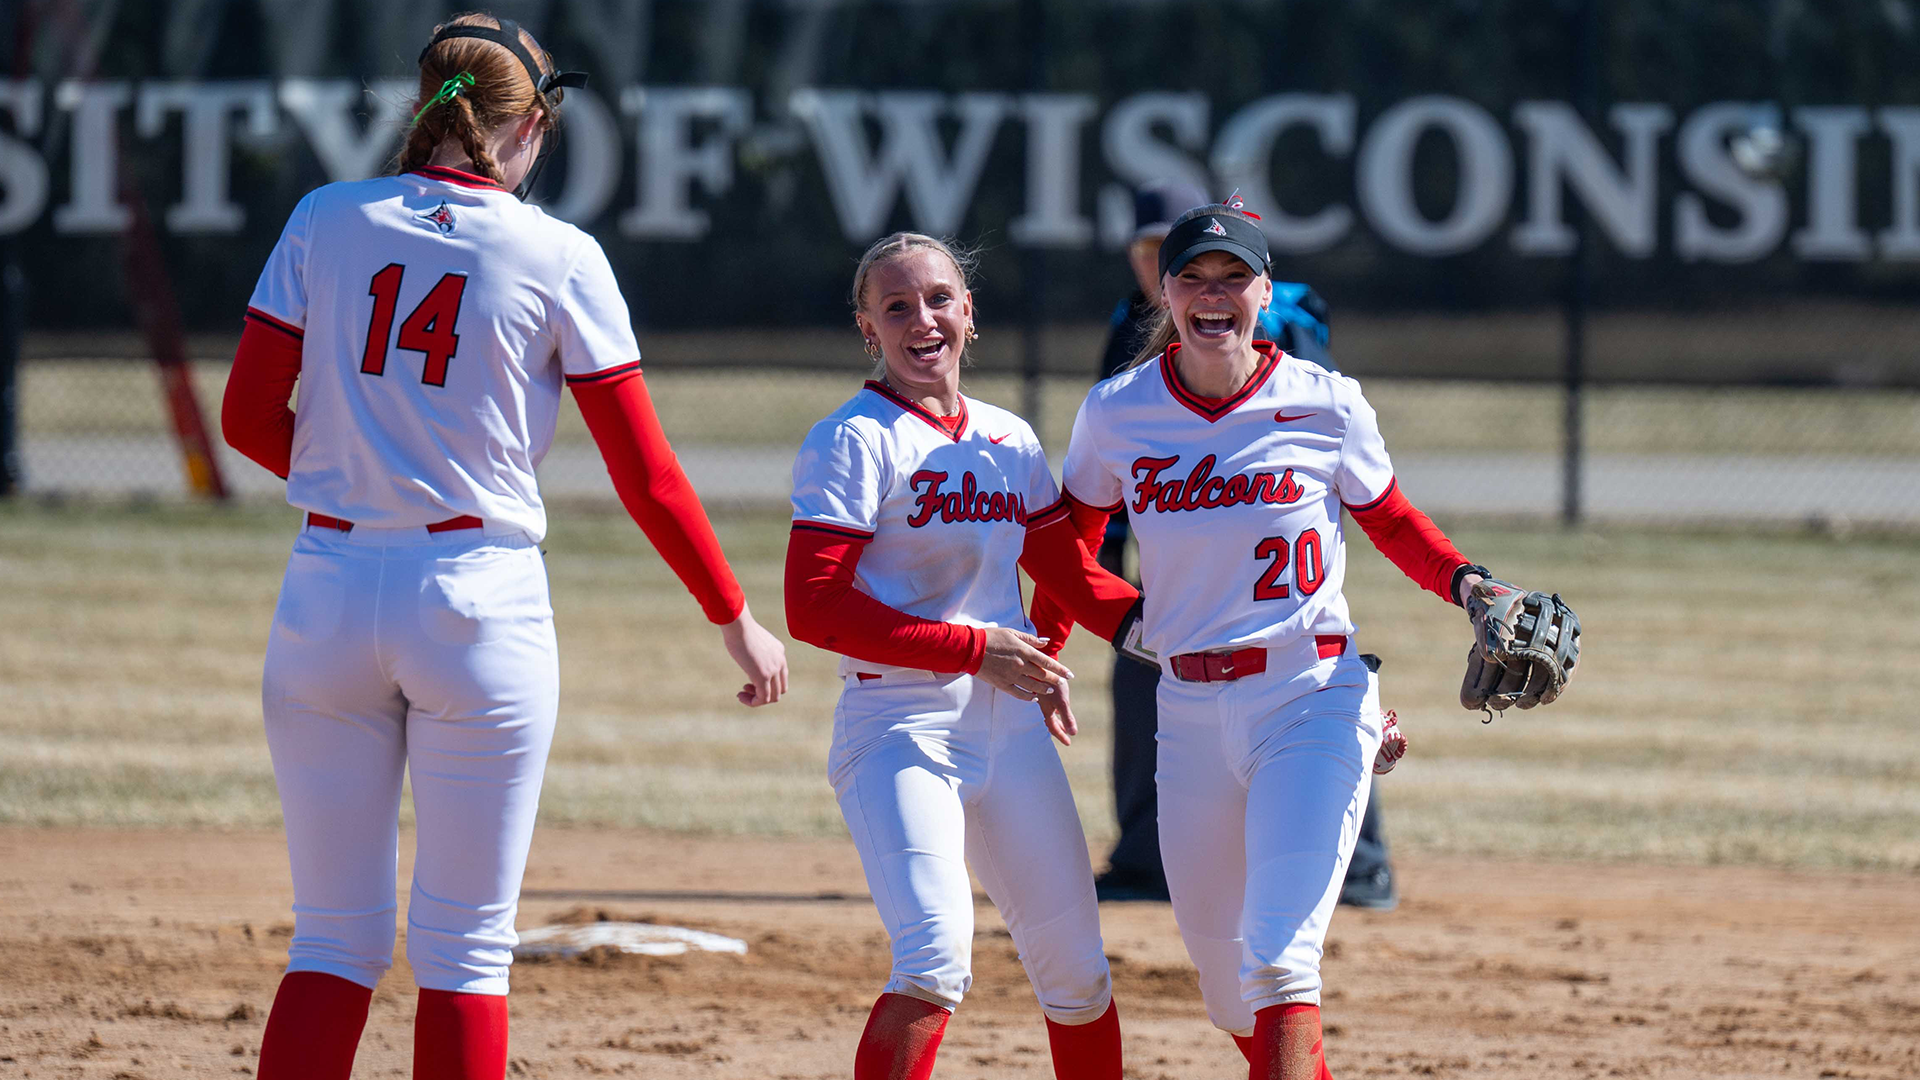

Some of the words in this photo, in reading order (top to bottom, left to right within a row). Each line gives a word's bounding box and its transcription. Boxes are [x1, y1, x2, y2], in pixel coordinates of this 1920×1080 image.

[790, 88, 1920, 265] WISCONSI
[360, 262, 468, 388] 14
[1131, 453, 1304, 514] Falcons
[1253, 527, 1325, 601] 20
